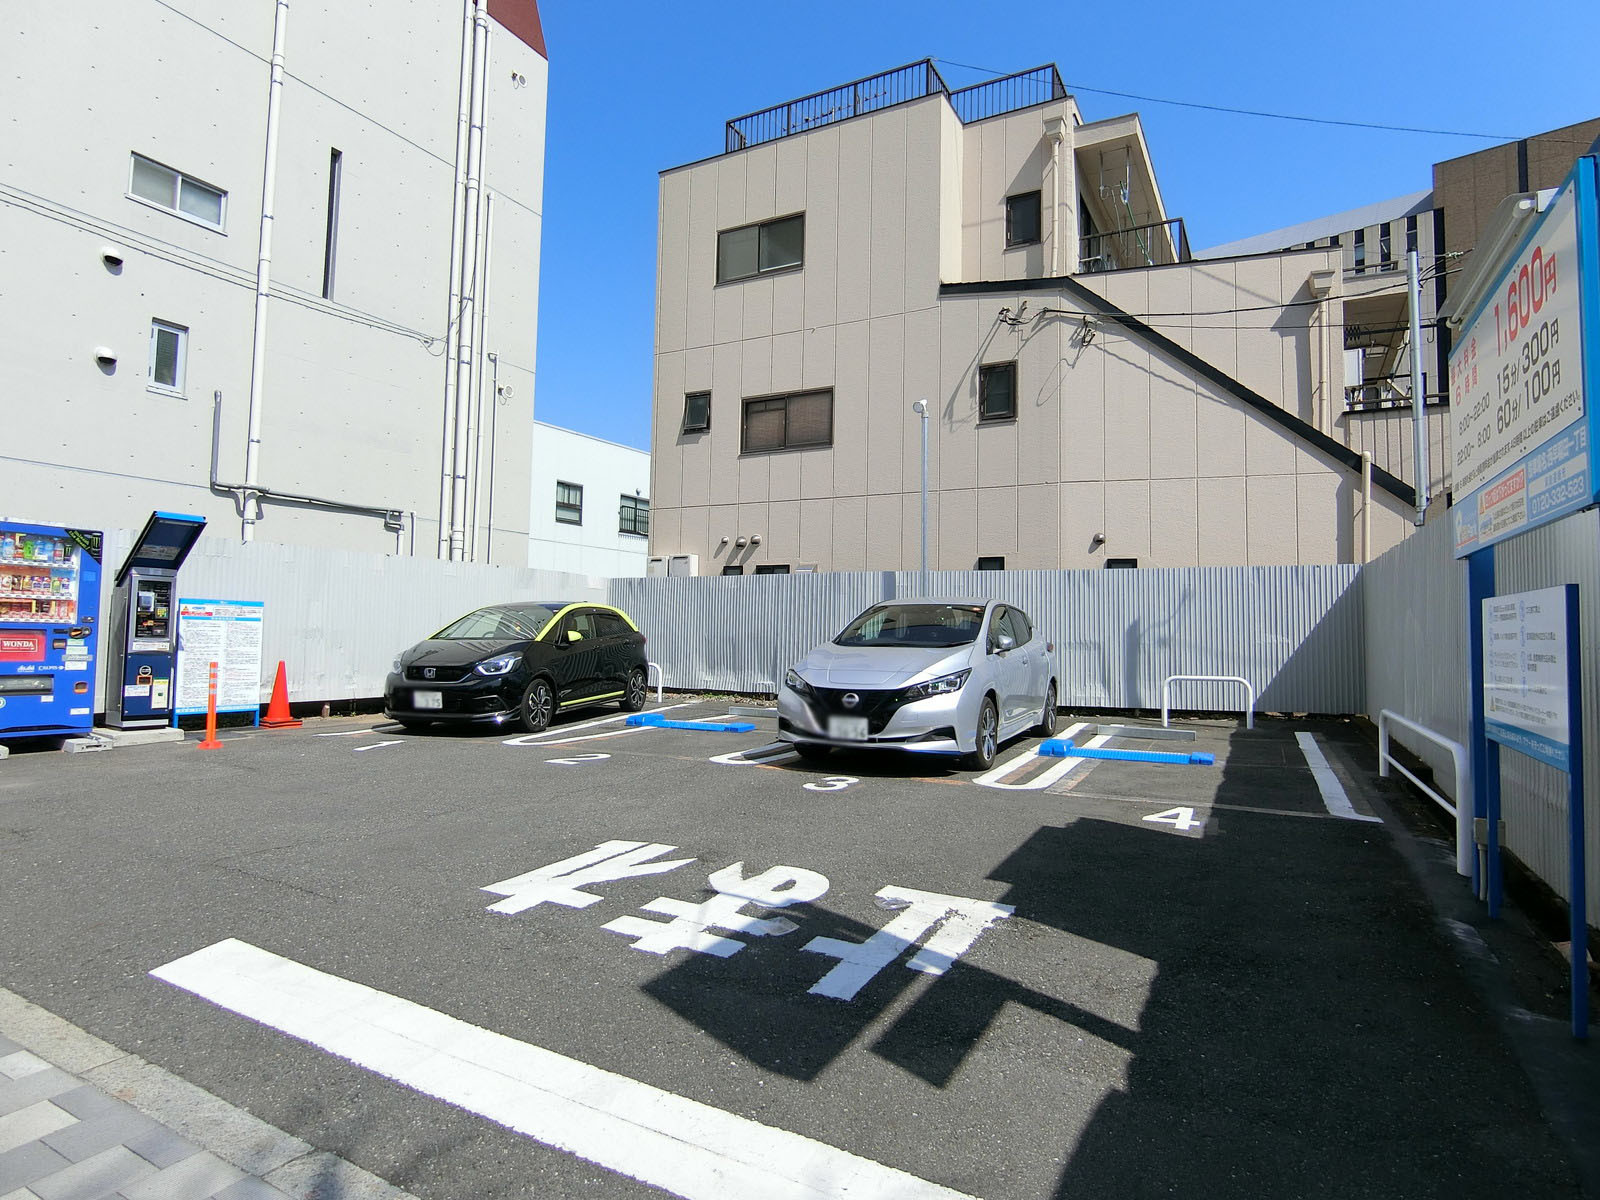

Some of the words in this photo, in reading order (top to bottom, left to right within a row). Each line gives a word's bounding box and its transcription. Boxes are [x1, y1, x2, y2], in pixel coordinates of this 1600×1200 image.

[1494, 246, 1557, 357] 1,600円
[2, 640, 35, 648] WONDA
[544, 753, 611, 765] 2
[802, 776, 860, 792] 3
[1142, 806, 1205, 830] 4
